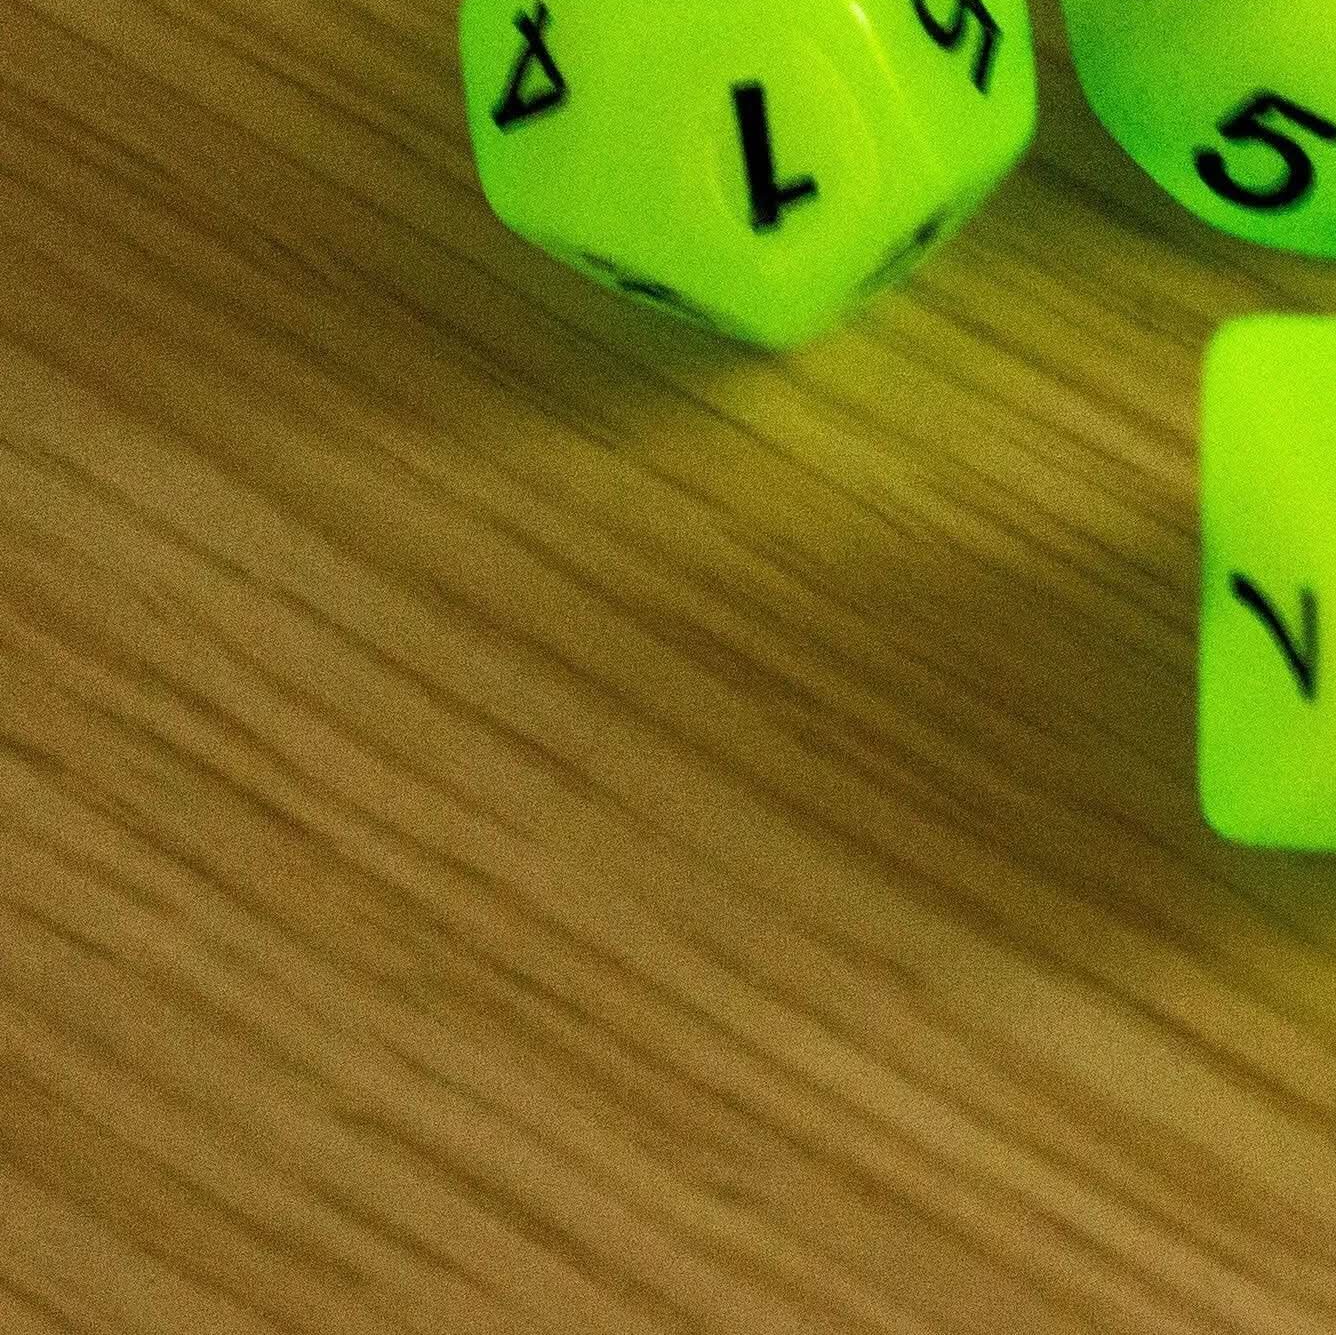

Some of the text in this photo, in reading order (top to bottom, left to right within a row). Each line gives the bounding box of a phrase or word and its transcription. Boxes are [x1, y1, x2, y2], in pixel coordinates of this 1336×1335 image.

[490, 1, 570, 133] 4
[729, 80, 819, 233] 1
[1227, 571, 1320, 701] 7
